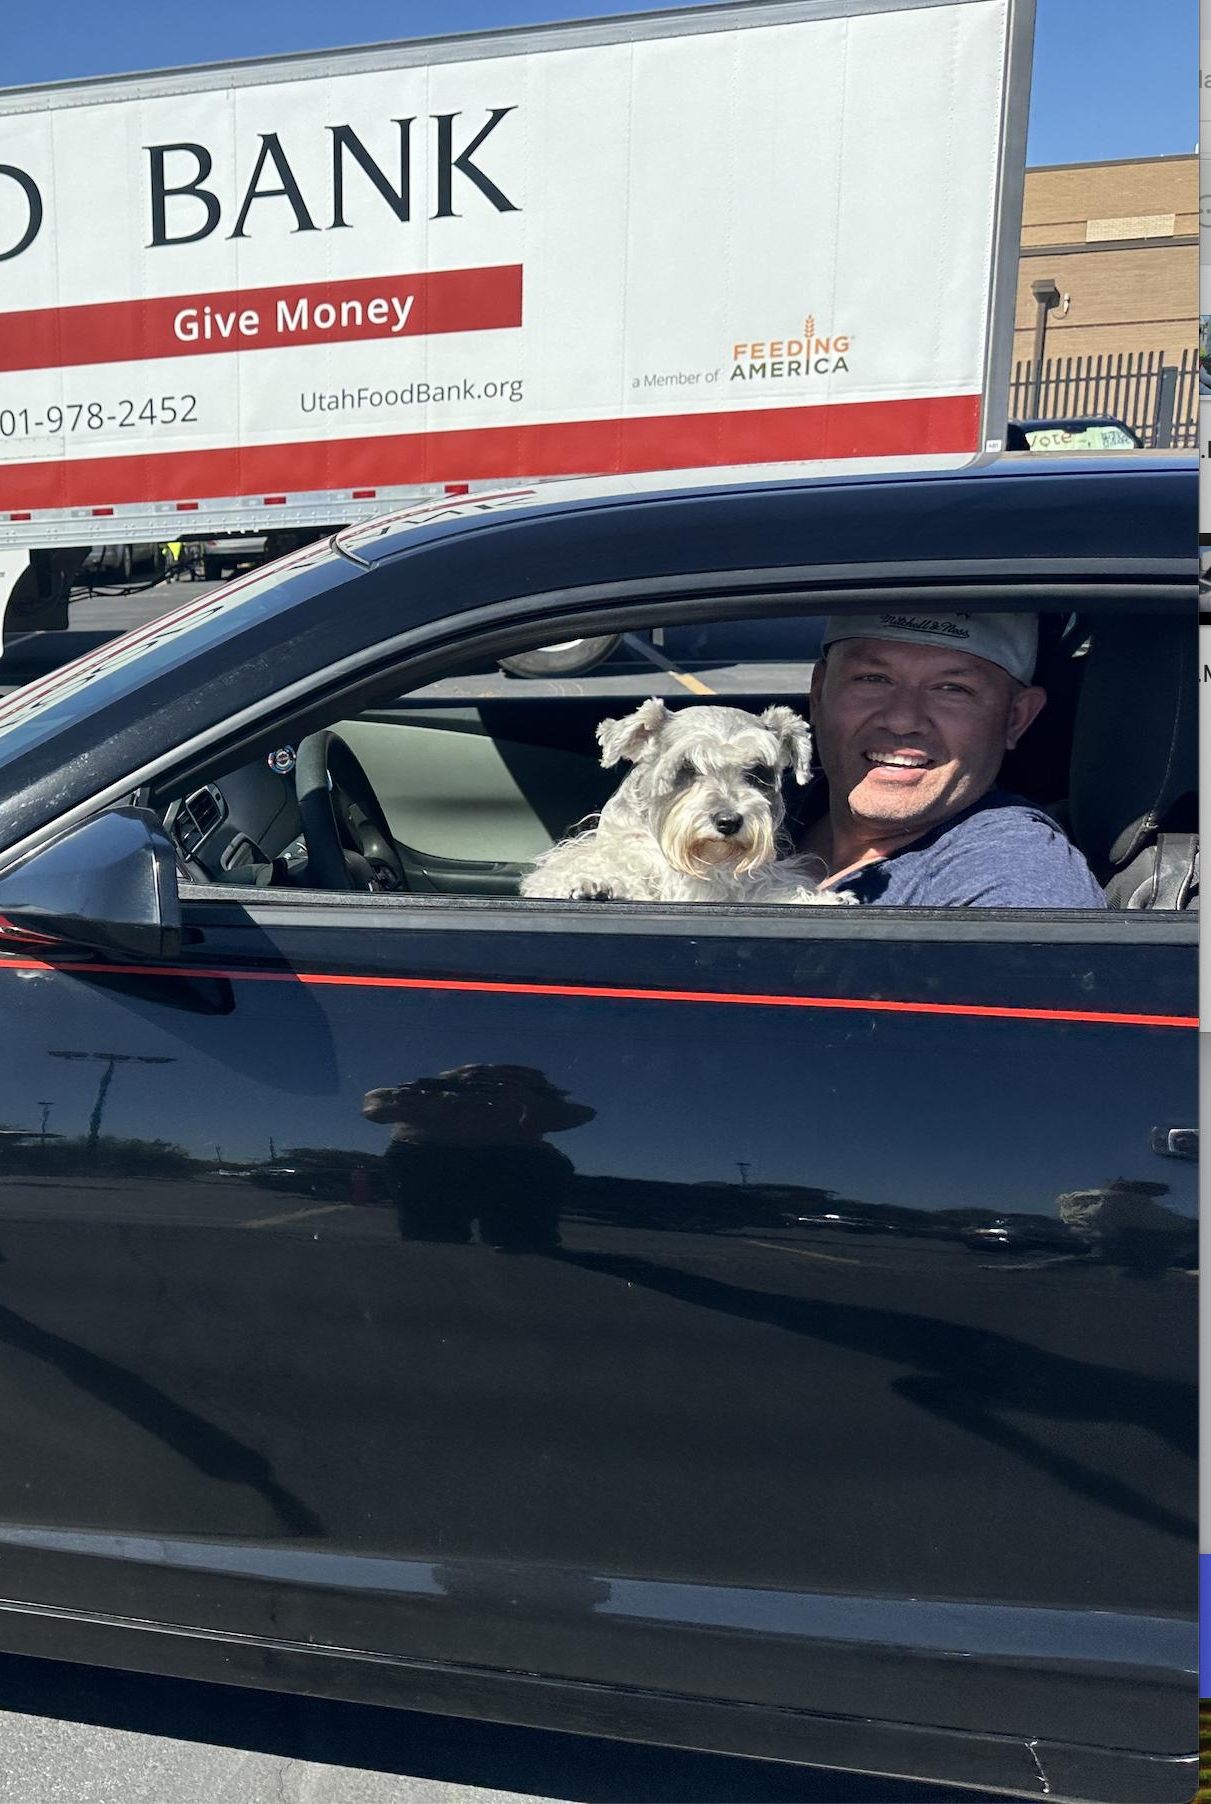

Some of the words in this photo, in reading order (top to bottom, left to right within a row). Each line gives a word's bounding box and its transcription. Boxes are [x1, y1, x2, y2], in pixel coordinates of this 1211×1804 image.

[142, 105, 523, 249] BANK
[173, 307, 260, 343] Give
[275, 294, 415, 334] Money
[732, 335, 850, 361] FEEDING
[631, 377, 640, 388] a
[644, 371, 701, 388] Member
[705, 369, 721, 383] of
[730, 356, 850, 381] AMERICA
[299, 375, 525, 414] UtahFoodBank.org
